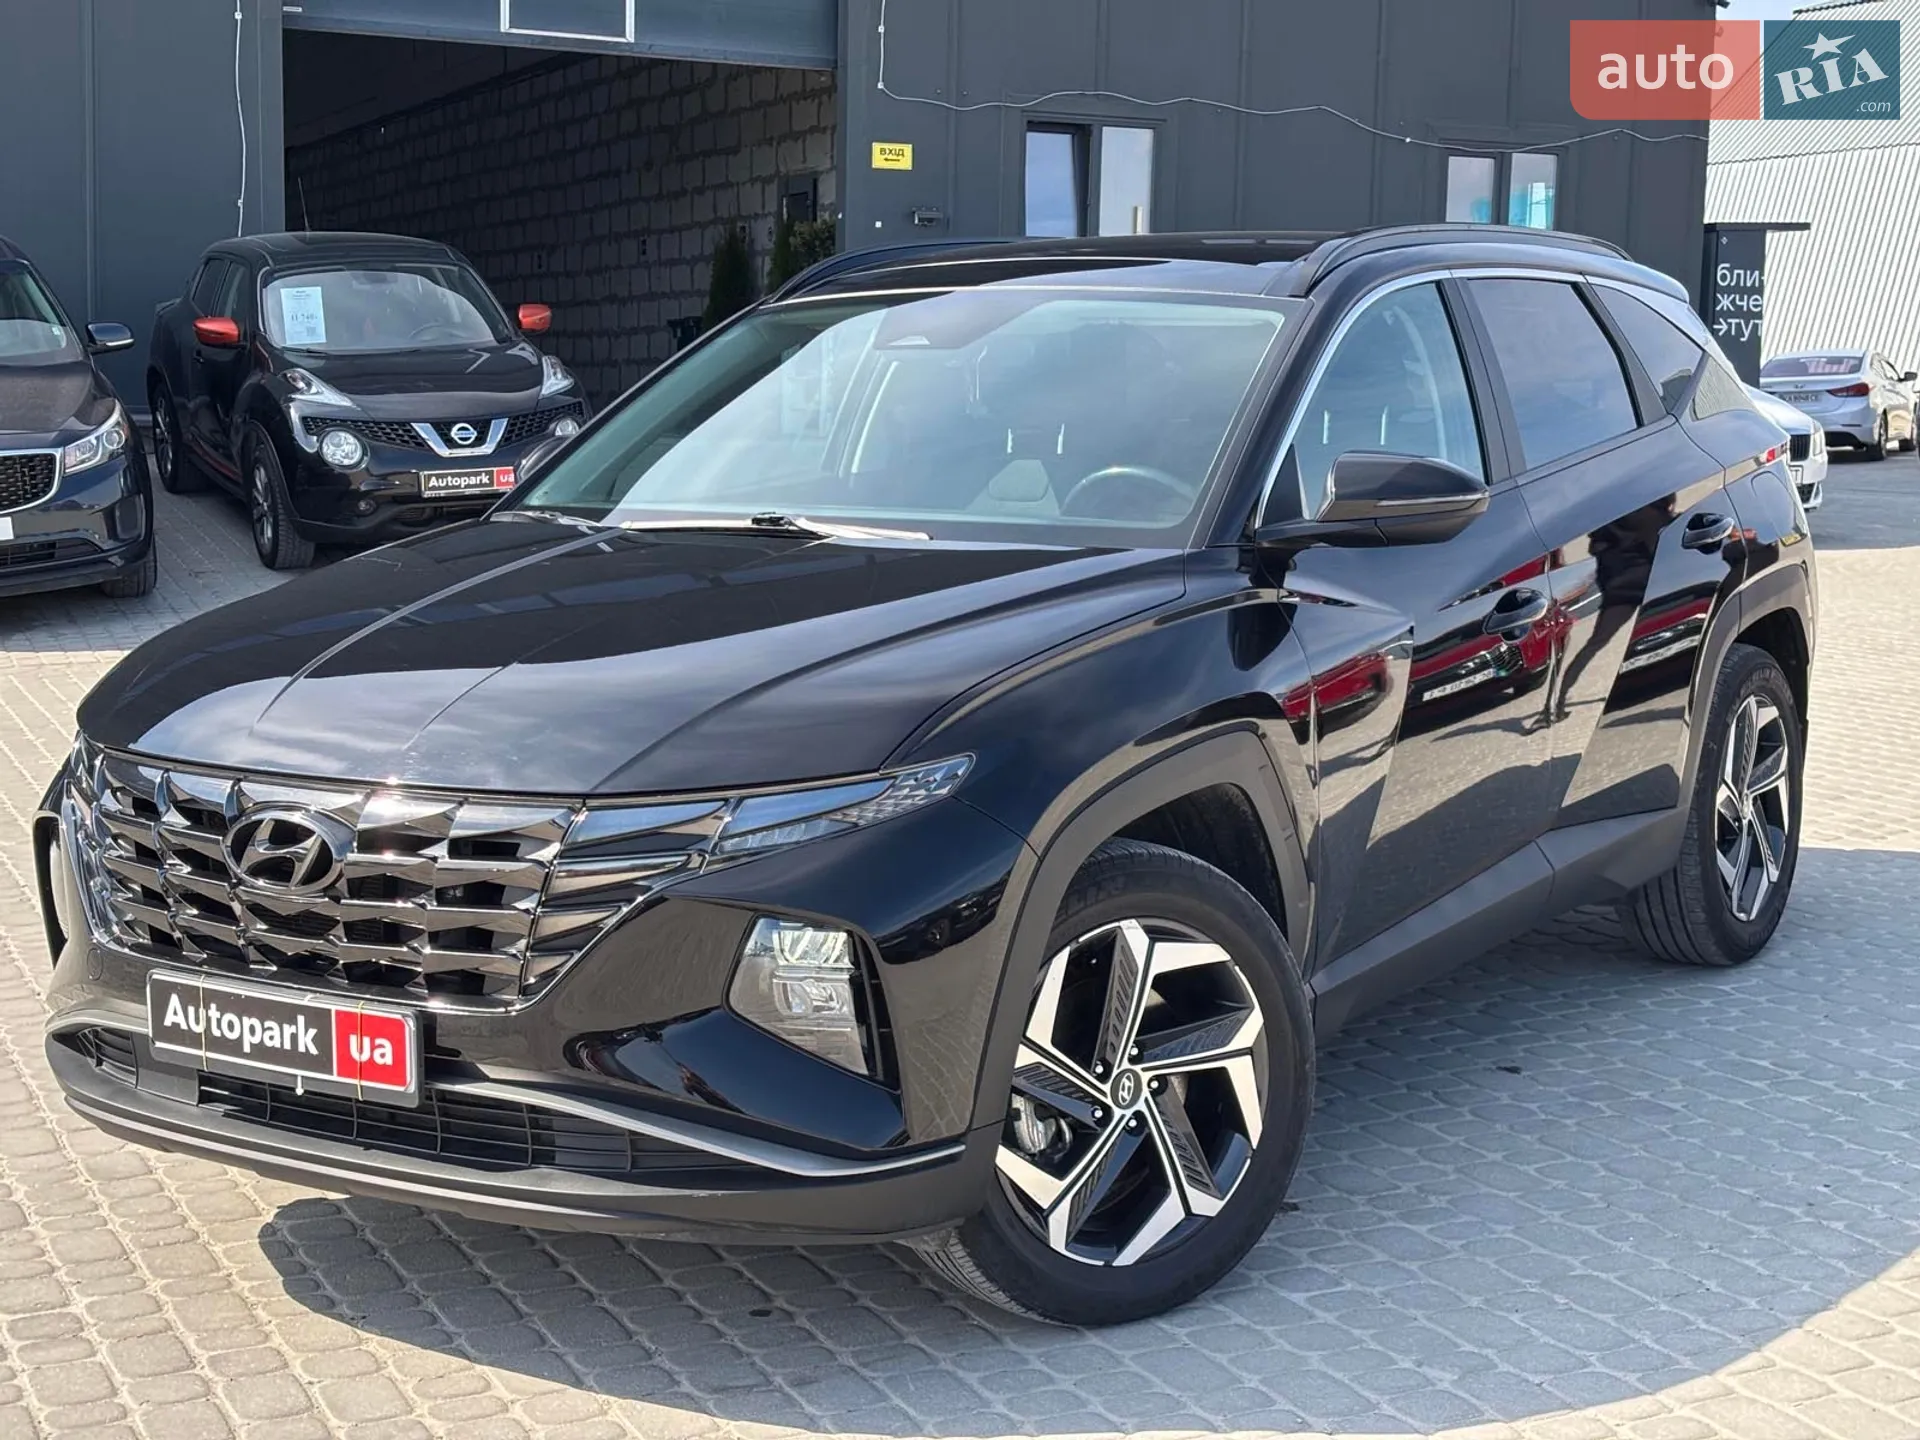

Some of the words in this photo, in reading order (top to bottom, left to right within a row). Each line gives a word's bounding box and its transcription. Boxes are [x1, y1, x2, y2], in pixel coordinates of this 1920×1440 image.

[879, 147, 905, 158] ВХІД
[1715, 293, 1763, 312] жче
[1727, 318, 1763, 342] тут
[428, 472, 490, 488] Autopark
[499, 473, 515, 483] ua
[163, 993, 319, 1056] Autopark
[349, 1032, 394, 1066] ua
